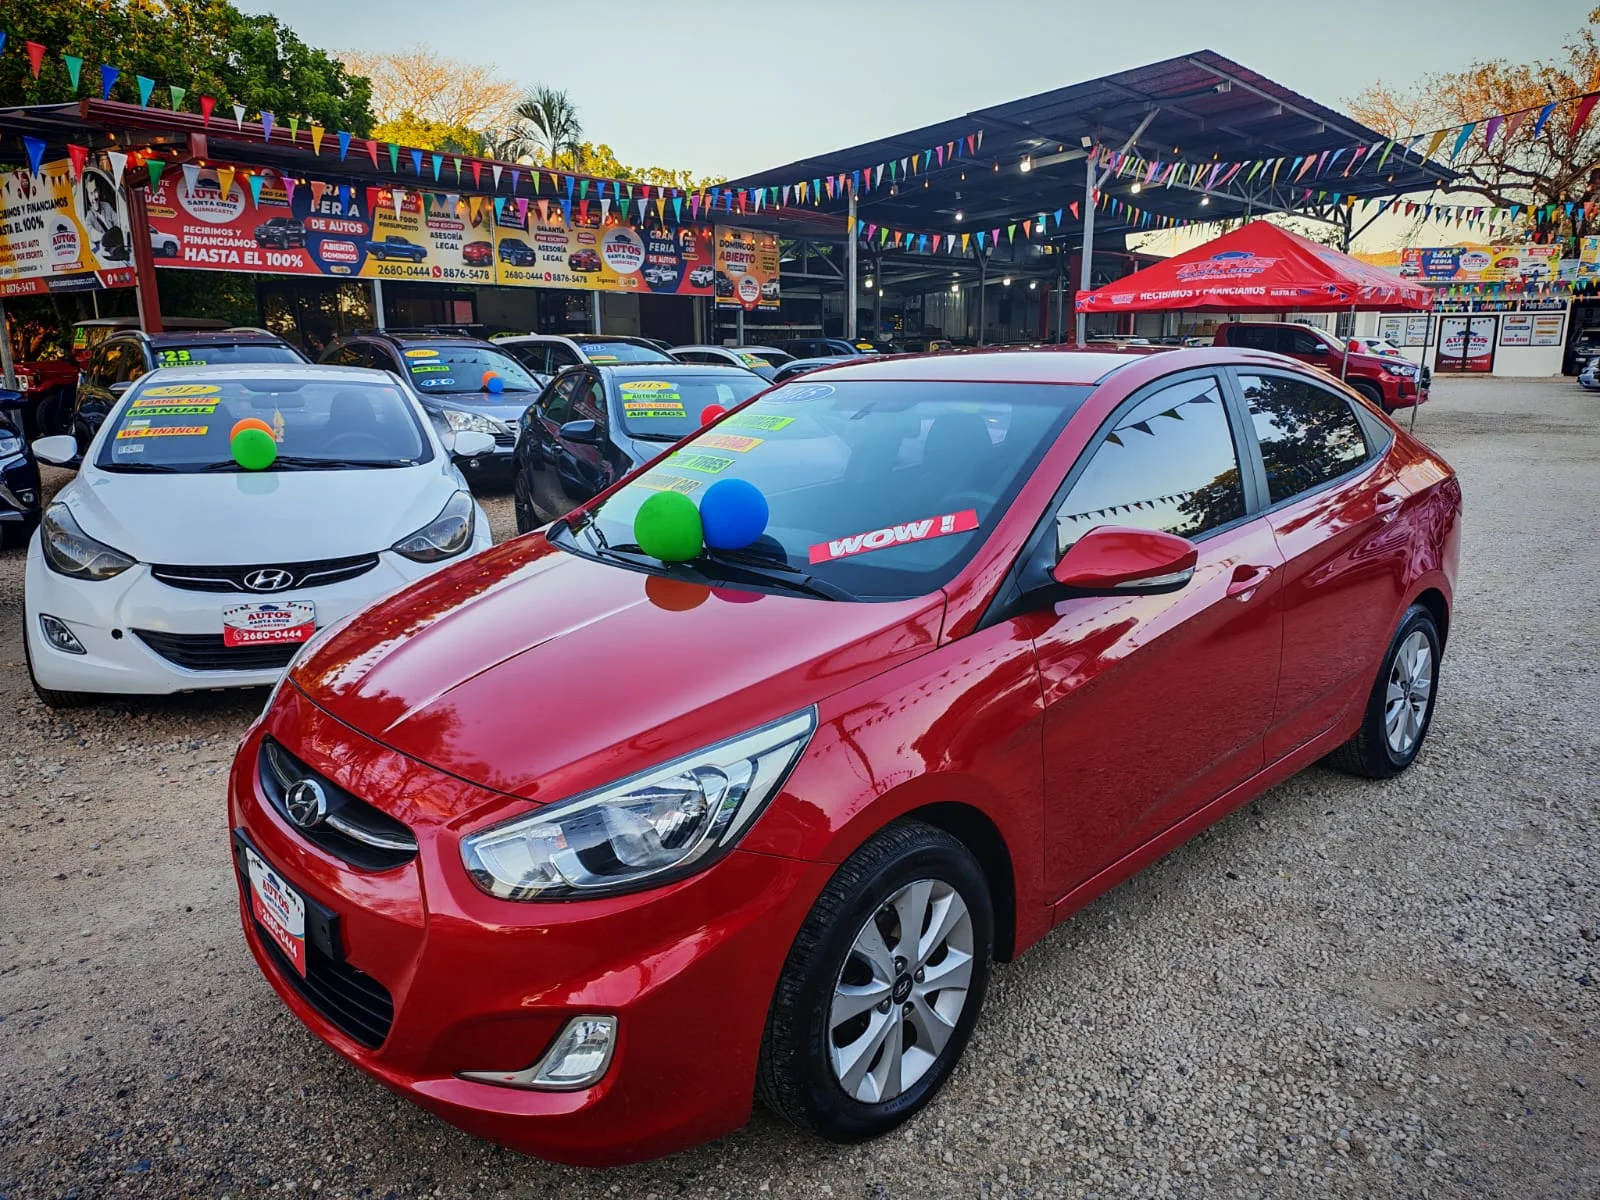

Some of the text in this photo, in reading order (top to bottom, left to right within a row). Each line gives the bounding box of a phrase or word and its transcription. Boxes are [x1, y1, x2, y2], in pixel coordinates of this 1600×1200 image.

[145, 195, 167, 205] UCR
[216, 201, 237, 210] CRUZ
[21, 205, 26, 215] Y
[27, 197, 69, 214] FINANCIAMOS
[193, 207, 234, 216] GUANACASTE
[310, 200, 360, 217] FERA
[15, 222, 23, 233] EL
[23, 215, 44, 231] 100%
[400, 216, 418, 224] TODO
[183, 226, 234, 237] RECIBIMOS
[311, 220, 363, 234] DE AUTOS
[379, 222, 419, 232] PRESUPUESTO
[441, 223, 463, 231] ESCRITO
[52, 233, 76, 245] AUTOS
[430, 231, 463, 241] ASESORÍA
[649, 230, 674, 241] GRAN
[28, 239, 40, 248] AUTO
[183, 236, 257, 249] FINANCIAMOS
[323, 243, 354, 252] ABIERTO
[436, 242, 459, 251] LEGAL
[649, 242, 675, 253] FERIA
[719, 239, 755, 252] DOMINGOS
[538, 244, 568, 253] ASESORÍA
[605, 244, 642, 256] AUTOS
[16, 252, 25, 261] POR
[26, 250, 44, 260] ESCRITO
[184, 248, 303, 268] HASTA EL 100%
[322, 252, 357, 261] DOMINGOS
[543, 254, 563, 263] LEGAL
[658, 256, 677, 264] AUTOS
[719, 251, 756, 264] ABIERTO
[1176, 259, 1276, 274] AUTOS
[377, 265, 490, 280] 2680-0444 8876-5478
[504, 270, 588, 284] 2680-0444 8876-5478
[1140, 289, 1193, 301] RECIBIMOS
[1195, 288, 1201, 297] Y
[1203, 286, 1266, 296] FINANCIAMOS
[1270, 289, 1290, 297] HASTA
[1290, 289, 1297, 297] EL
[139, 398, 183, 406] FAMILY
[128, 406, 211, 416] MANUAL
[122, 426, 202, 438] WE FINANCE
[829, 519, 934, 557] WOW
[248, 611, 292, 621] AUTOS
[243, 630, 303, 641] 2680-0444
[262, 879, 290, 915] AUTOS
[263, 891, 277, 906] SANTA
[262, 908, 298, 960] 2680-0444
